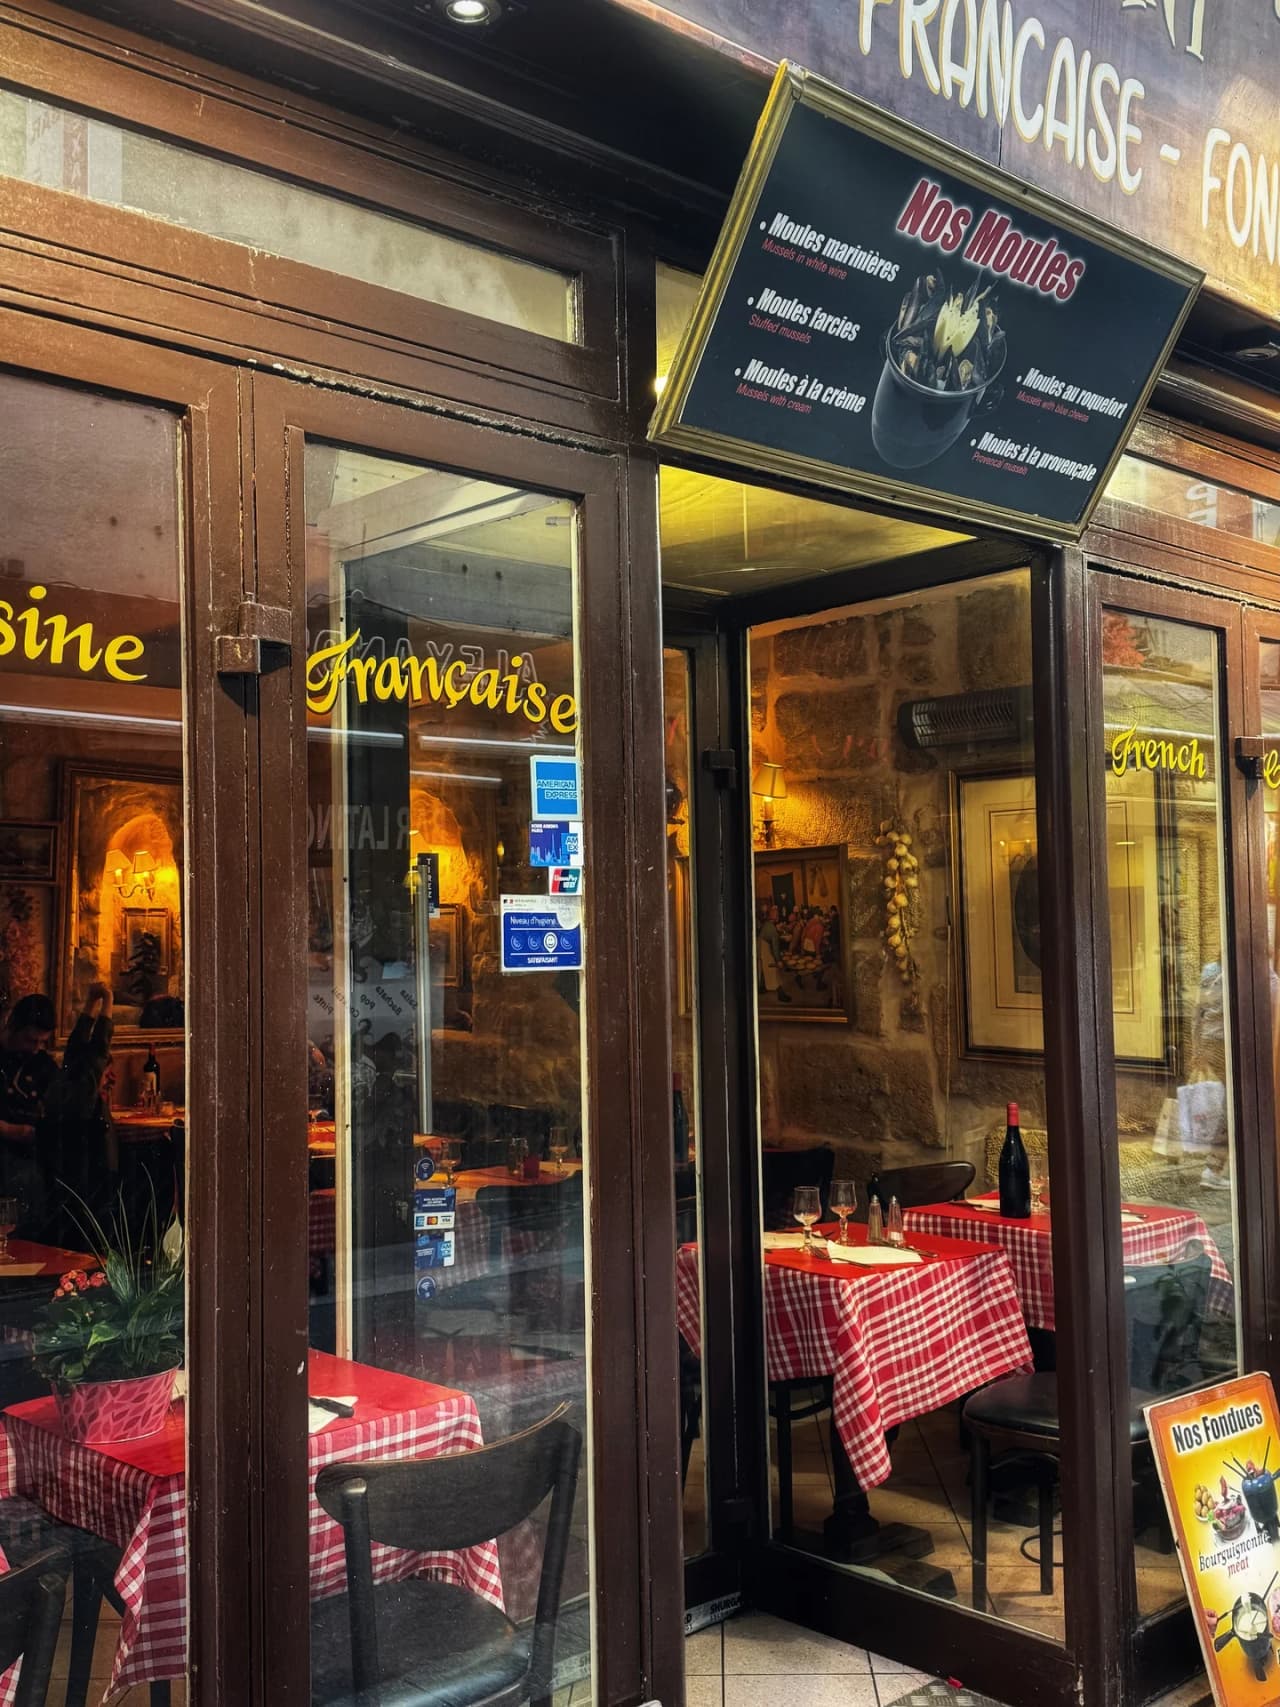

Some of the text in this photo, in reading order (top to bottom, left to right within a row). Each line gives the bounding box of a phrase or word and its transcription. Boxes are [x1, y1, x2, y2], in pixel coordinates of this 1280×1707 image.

[1201, 127, 1280, 266] FON
[762, 238, 796, 259] Mussels
[805, 254, 828, 273] white
[827, 263, 848, 280] wine
[768, 212, 900, 282] Moules marinières
[896, 177, 1086, 302] Nos Moules
[749, 313, 812, 344] Stuffed mussels
[755, 287, 861, 342] Moules farcies
[736, 382, 812, 415] Mussels with cream
[743, 358, 866, 413] Moules à la crème
[1022, 367, 1128, 419] Moules au roquefort
[977, 431, 1097, 482] Moules à la provençale
[306, 628, 578, 734] Française
[1111, 721, 1207, 779] French
[537, 779, 576, 790] AMERICAN
[545, 790, 577, 800] EXPRESS
[1172, 1402, 1263, 1453] Nos Fondues
[1199, 1530, 1269, 1572] Bourguignonne
[1227, 1556, 1250, 1578] meat
